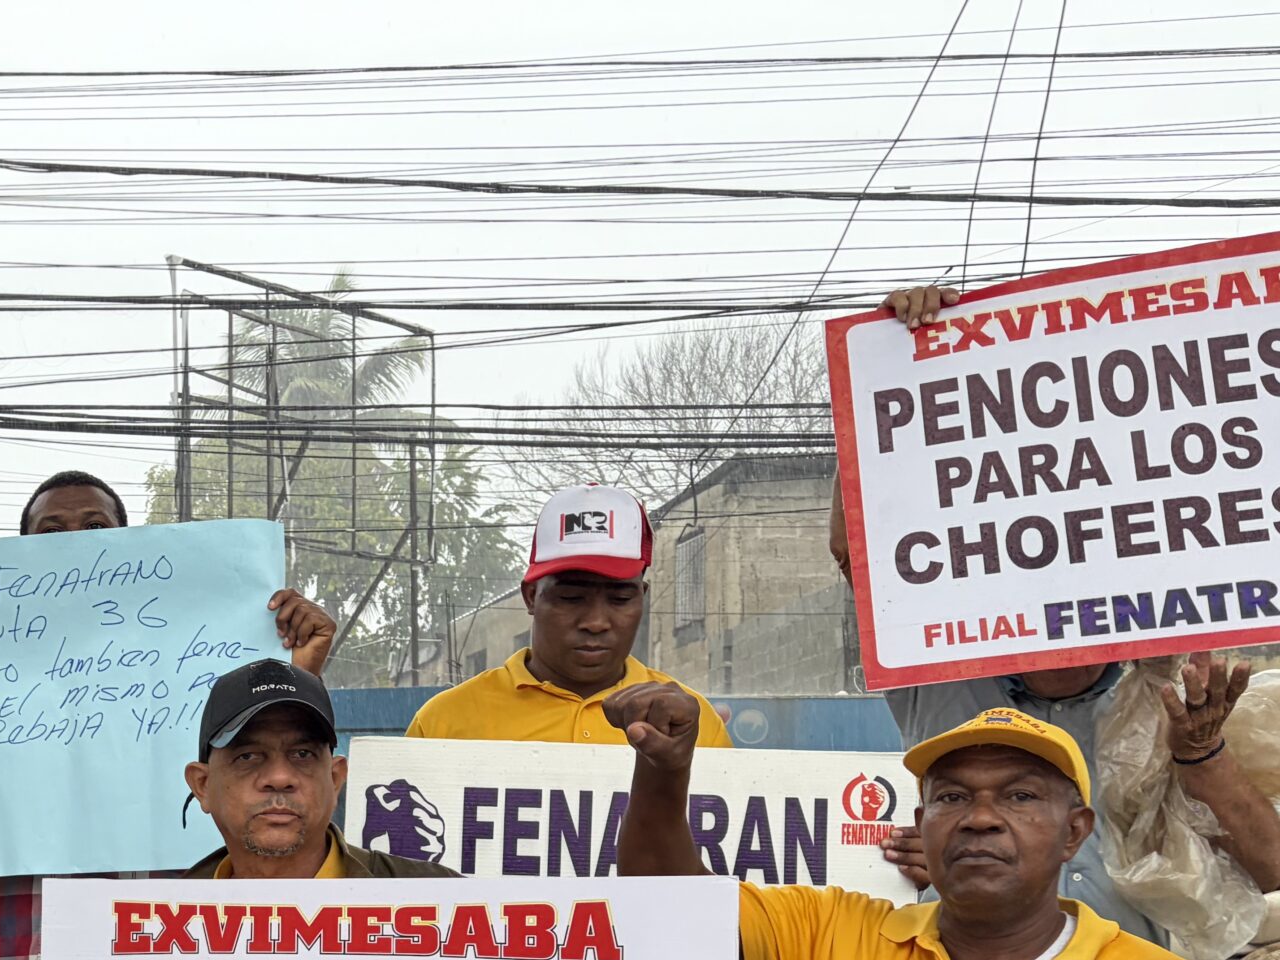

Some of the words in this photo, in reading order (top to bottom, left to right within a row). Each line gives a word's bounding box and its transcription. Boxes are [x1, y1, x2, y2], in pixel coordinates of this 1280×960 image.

[934, 436, 1112, 508] PARA
[1130, 416, 1263, 482] LOS
[893, 487, 1280, 584] CHOFERE
[92, 597, 168, 628] 36
[923, 613, 1037, 648] FILIAL
[1044, 580, 1280, 640] FENATR
[461, 786, 828, 886] FENARAN
